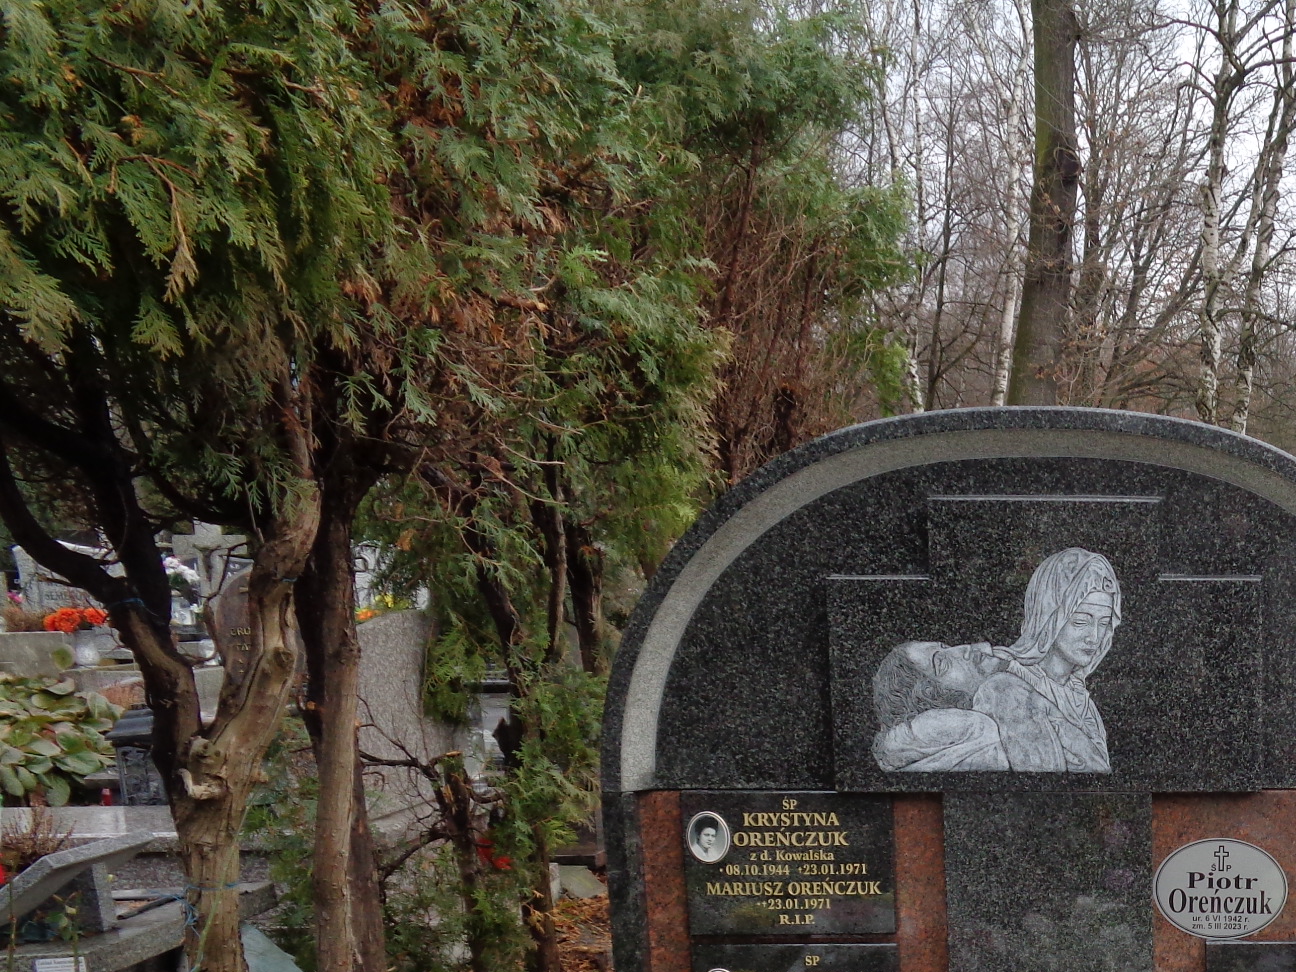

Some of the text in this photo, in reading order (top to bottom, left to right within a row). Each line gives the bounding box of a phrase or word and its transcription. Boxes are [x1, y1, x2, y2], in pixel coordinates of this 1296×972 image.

[742, 811, 840, 827] KRYSTYNA
[732, 826, 849, 847] OREŃCZUK
[775, 849, 835, 861] Kowalska
[706, 877, 882, 896] MARIUSZ OREŃCZUK
[1186, 871, 1259, 890] Piotr
[1168, 888, 1273, 915] Oreńczuk
[1223, 915, 1242, 923] 1942
[1223, 922, 1242, 930] 2023
